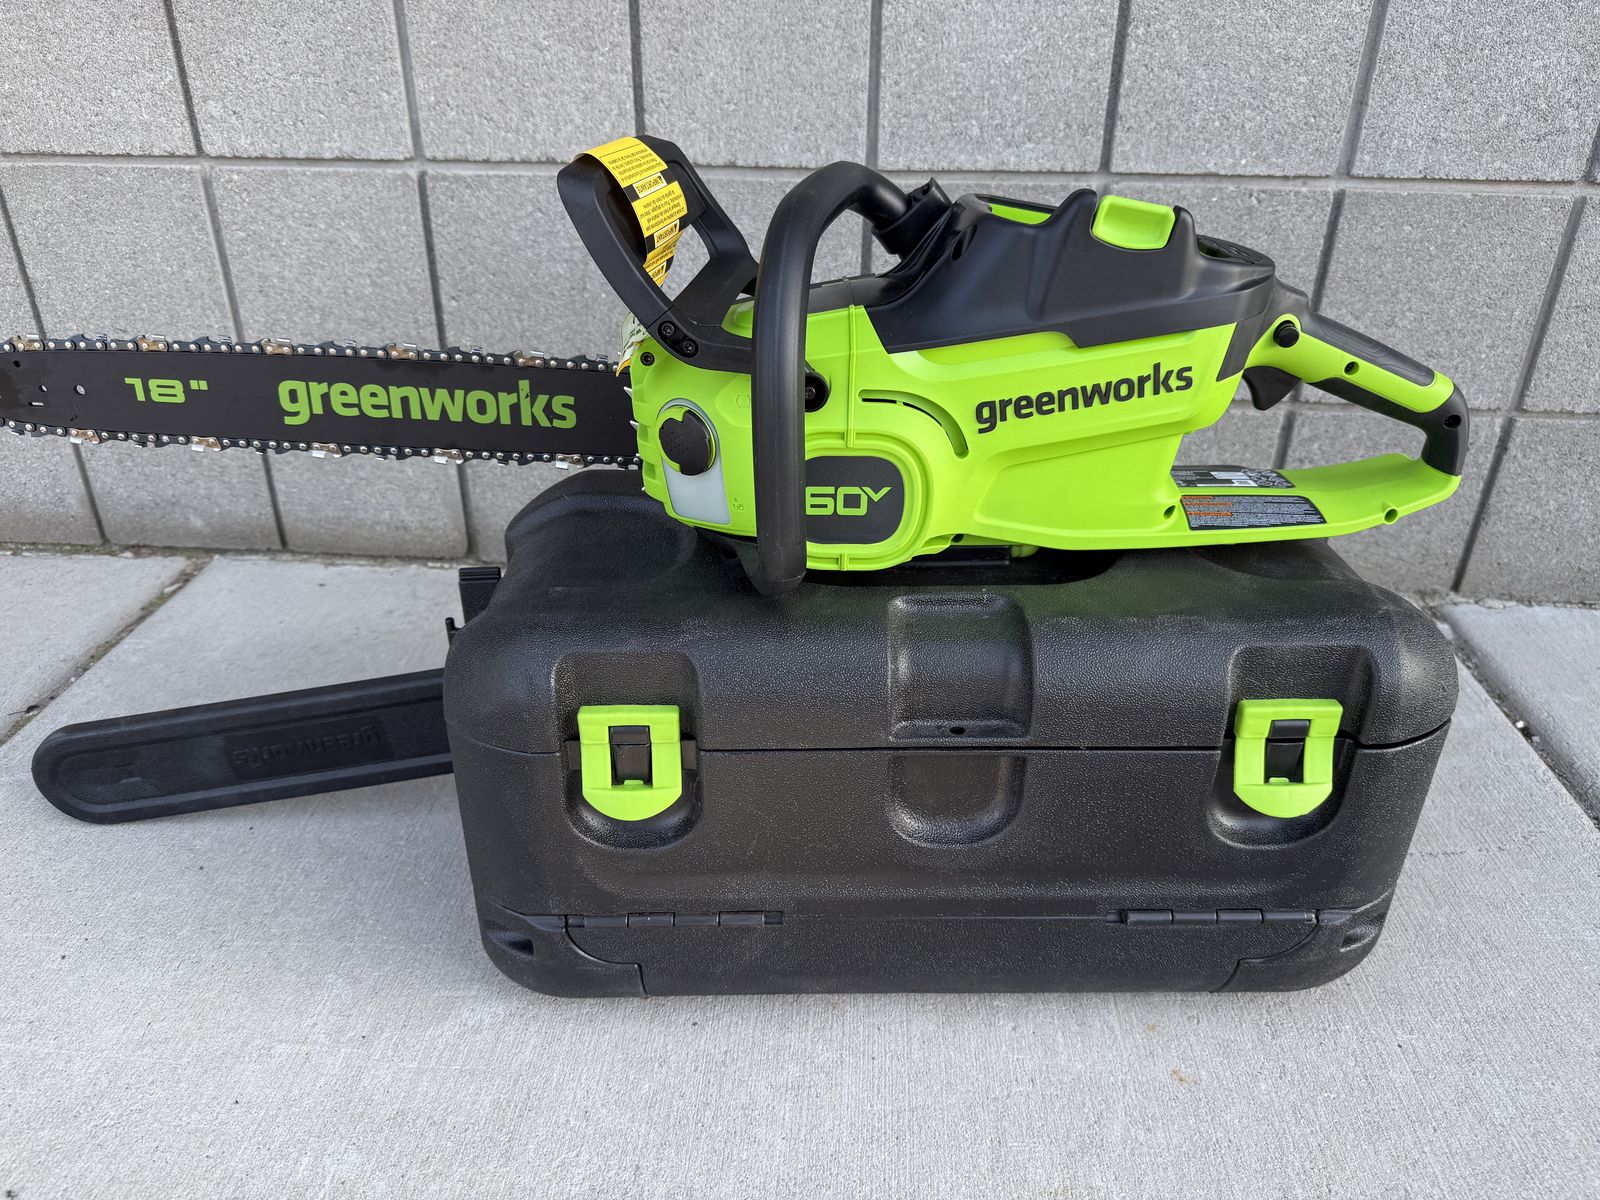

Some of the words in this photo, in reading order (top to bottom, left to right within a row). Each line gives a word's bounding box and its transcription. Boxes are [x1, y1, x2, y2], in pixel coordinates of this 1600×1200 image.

[124, 377, 208, 404] 18"
[278, 379, 577, 429] greenworks
[975, 362, 1193, 434] greenworks
[805, 486, 892, 516] 60V
